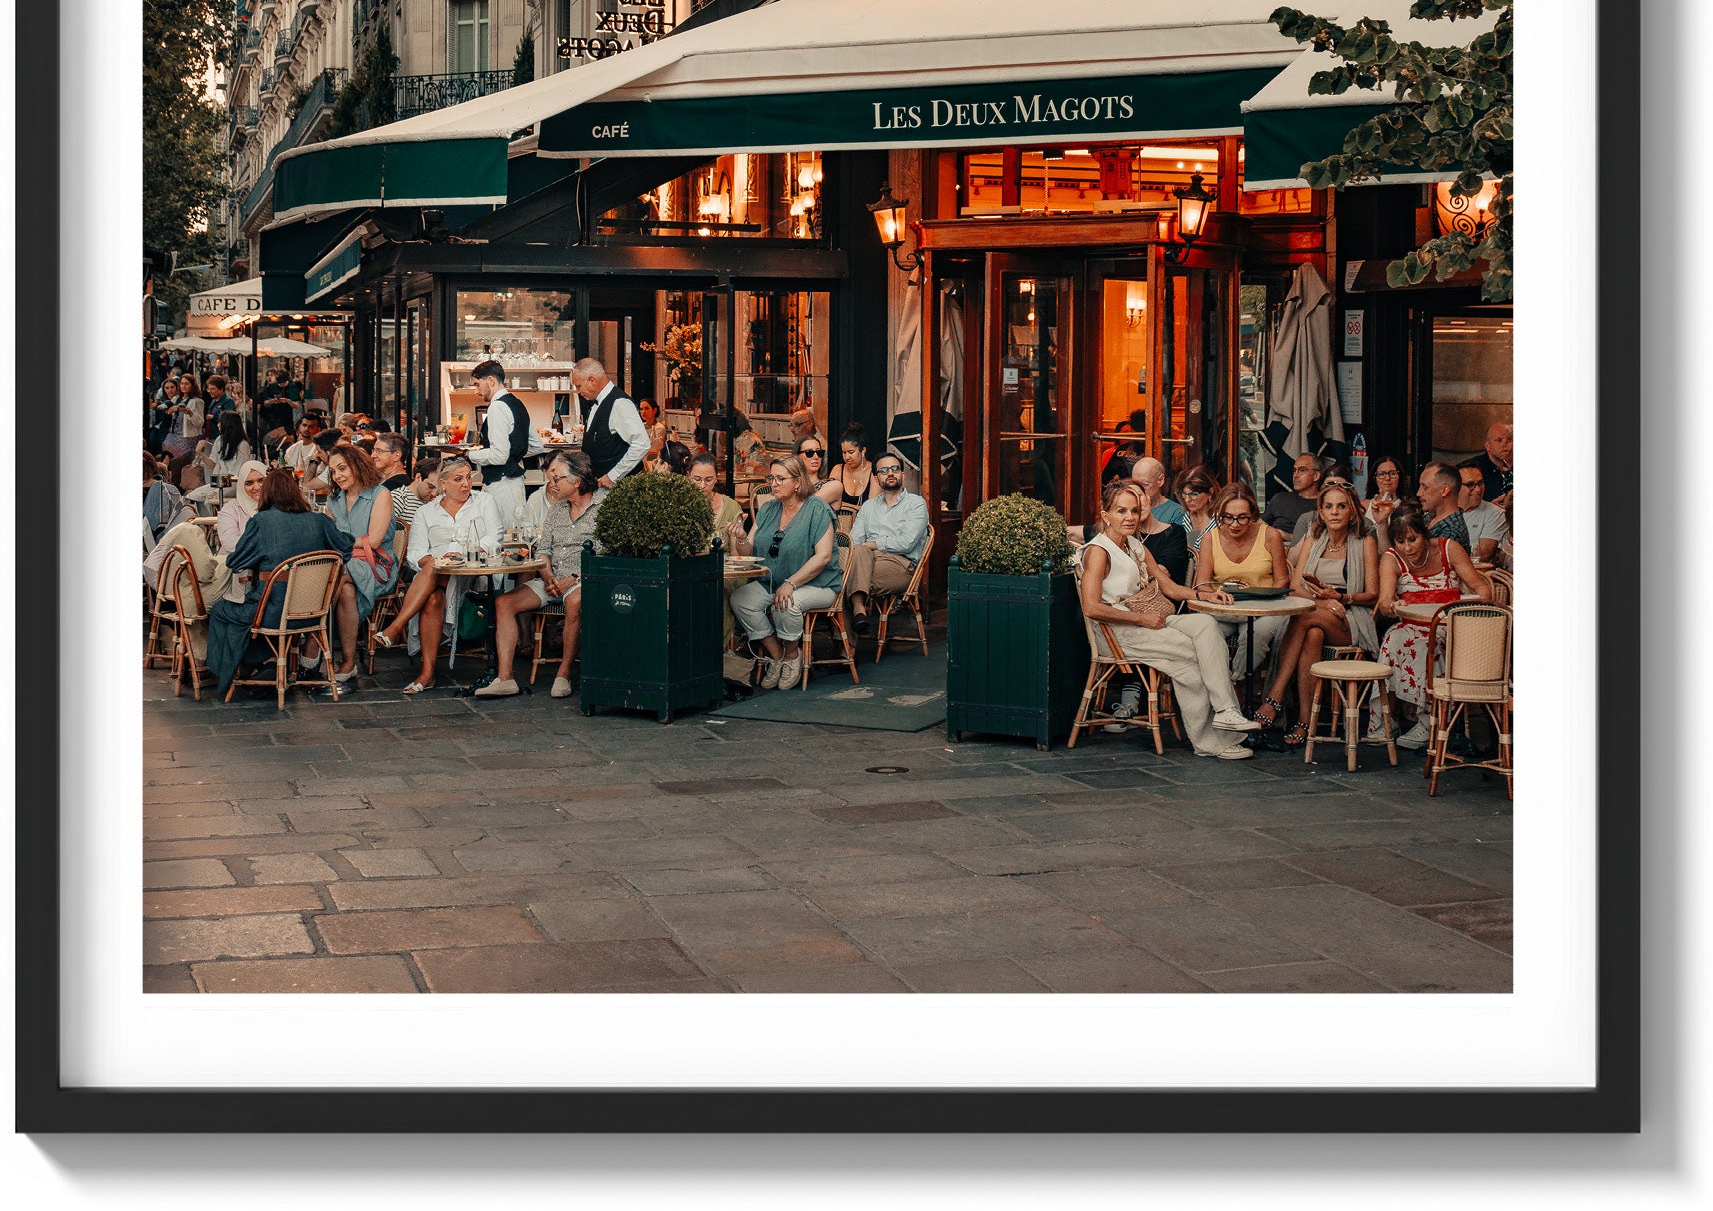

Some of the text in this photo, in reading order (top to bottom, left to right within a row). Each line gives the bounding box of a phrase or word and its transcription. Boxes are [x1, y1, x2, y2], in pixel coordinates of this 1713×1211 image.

[872, 94, 1134, 130] LES DEUX MAGOTS
[592, 121, 630, 138] CAFÉ
[198, 298, 236, 311] CAFE
